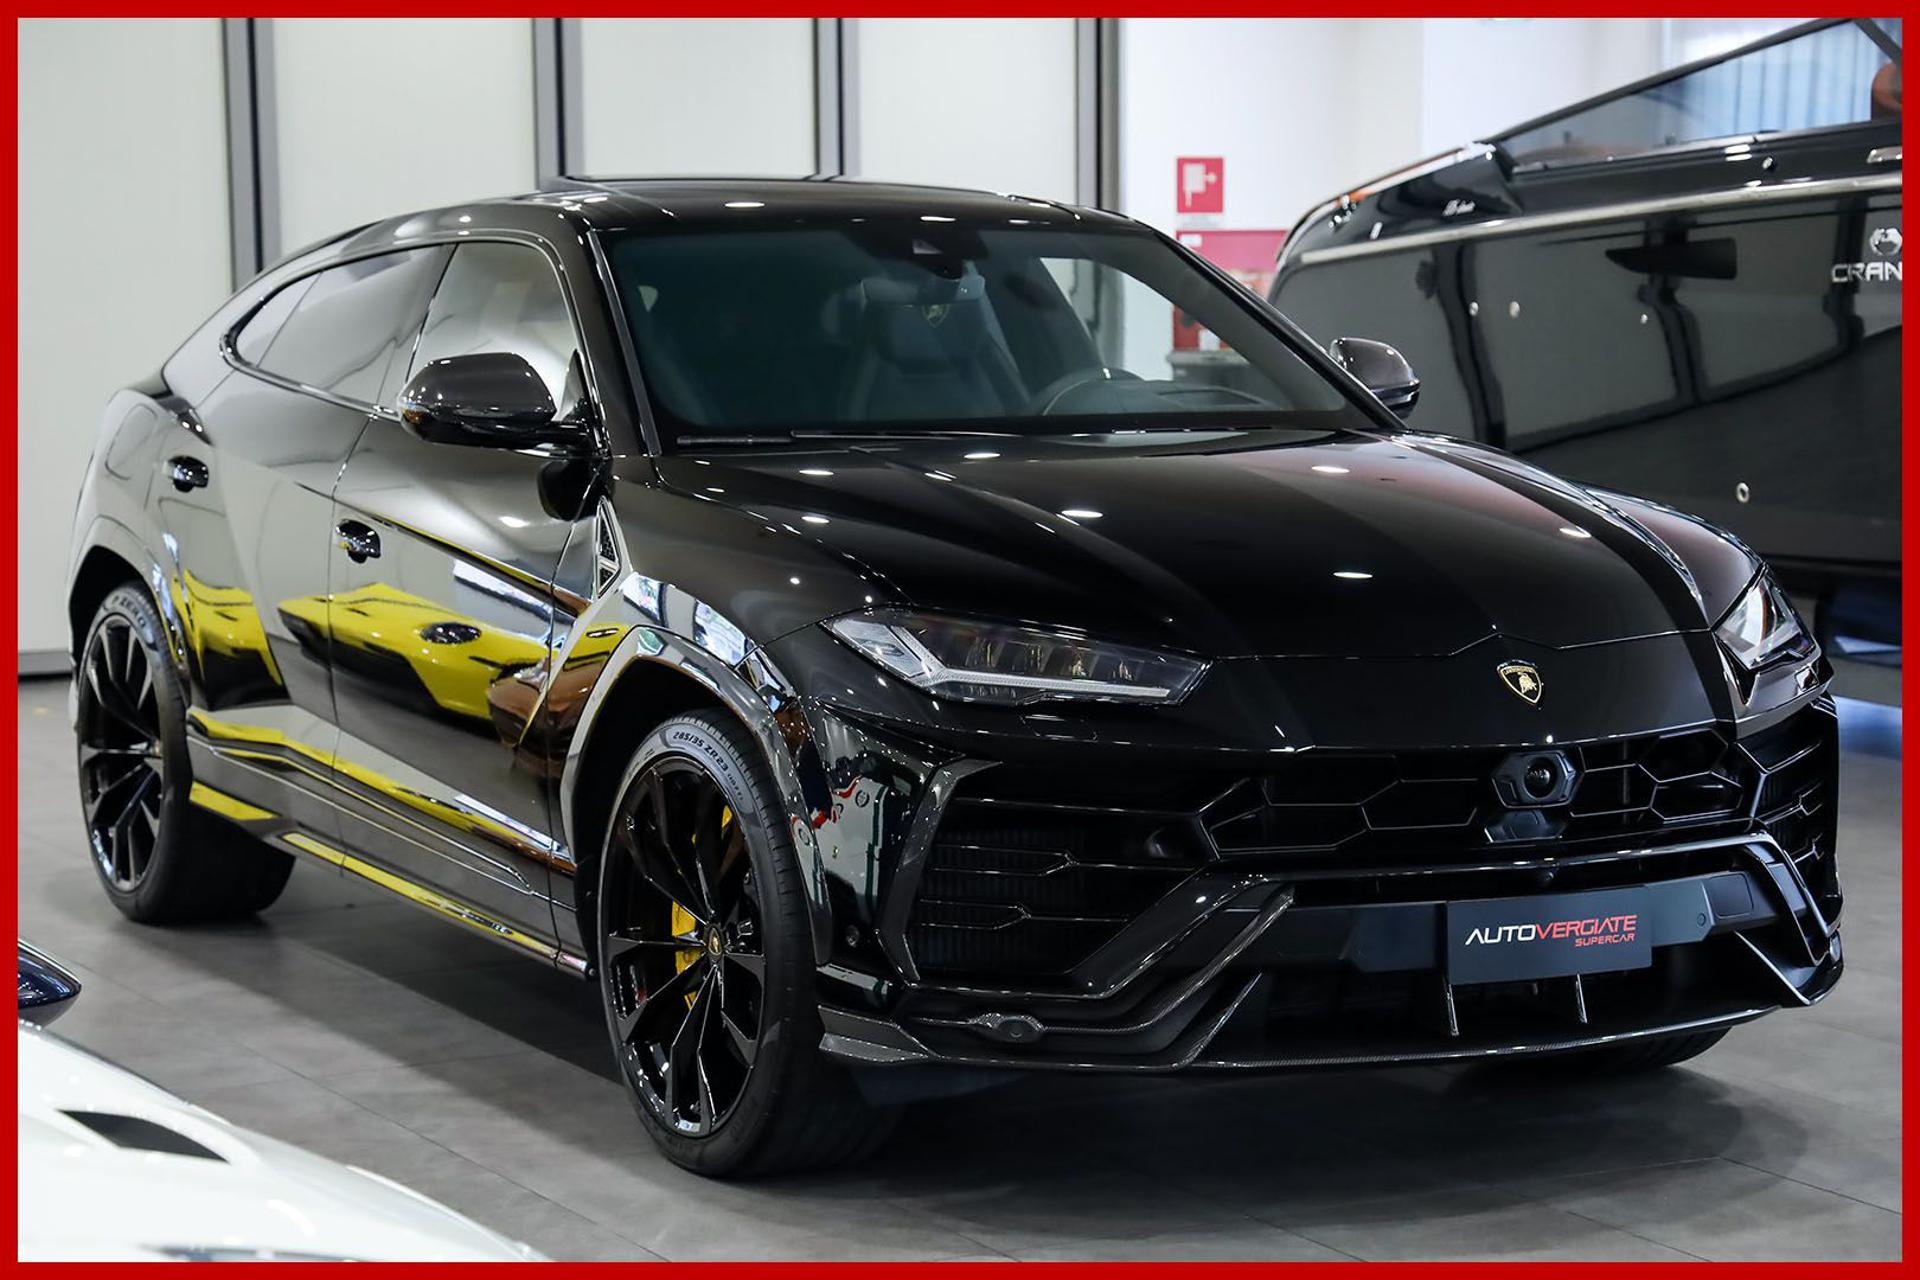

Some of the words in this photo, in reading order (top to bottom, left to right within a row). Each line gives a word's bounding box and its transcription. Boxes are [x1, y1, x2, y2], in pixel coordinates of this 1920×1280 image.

[673, 731, 705, 747] 285/35
[1465, 915, 1638, 945] AUTOVERGIATE
[1575, 932, 1635, 947] SUPERCAR
